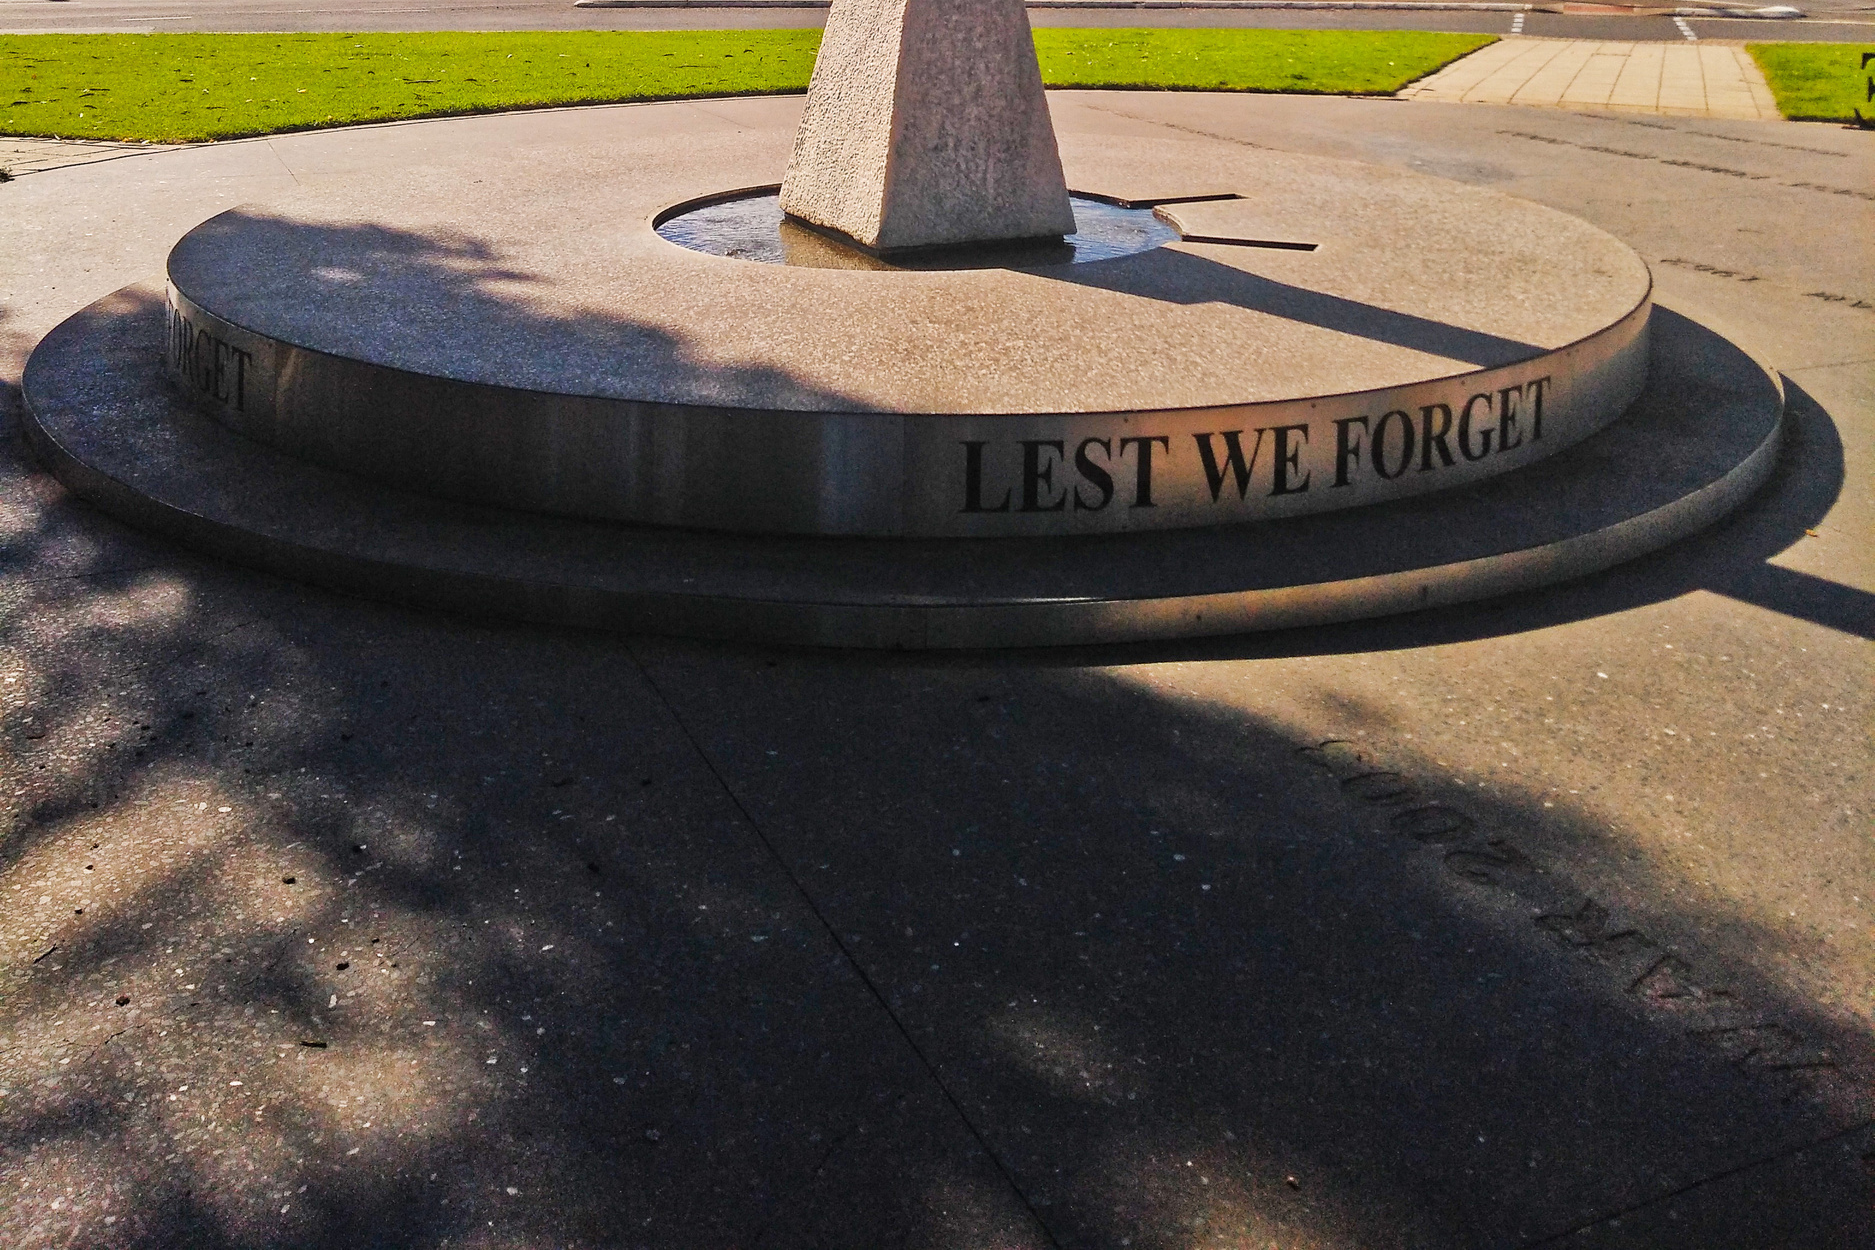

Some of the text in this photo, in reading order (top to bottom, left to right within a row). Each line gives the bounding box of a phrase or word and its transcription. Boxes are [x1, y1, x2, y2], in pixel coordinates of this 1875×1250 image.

[958, 376, 1552, 514] LEST WE FORGET
